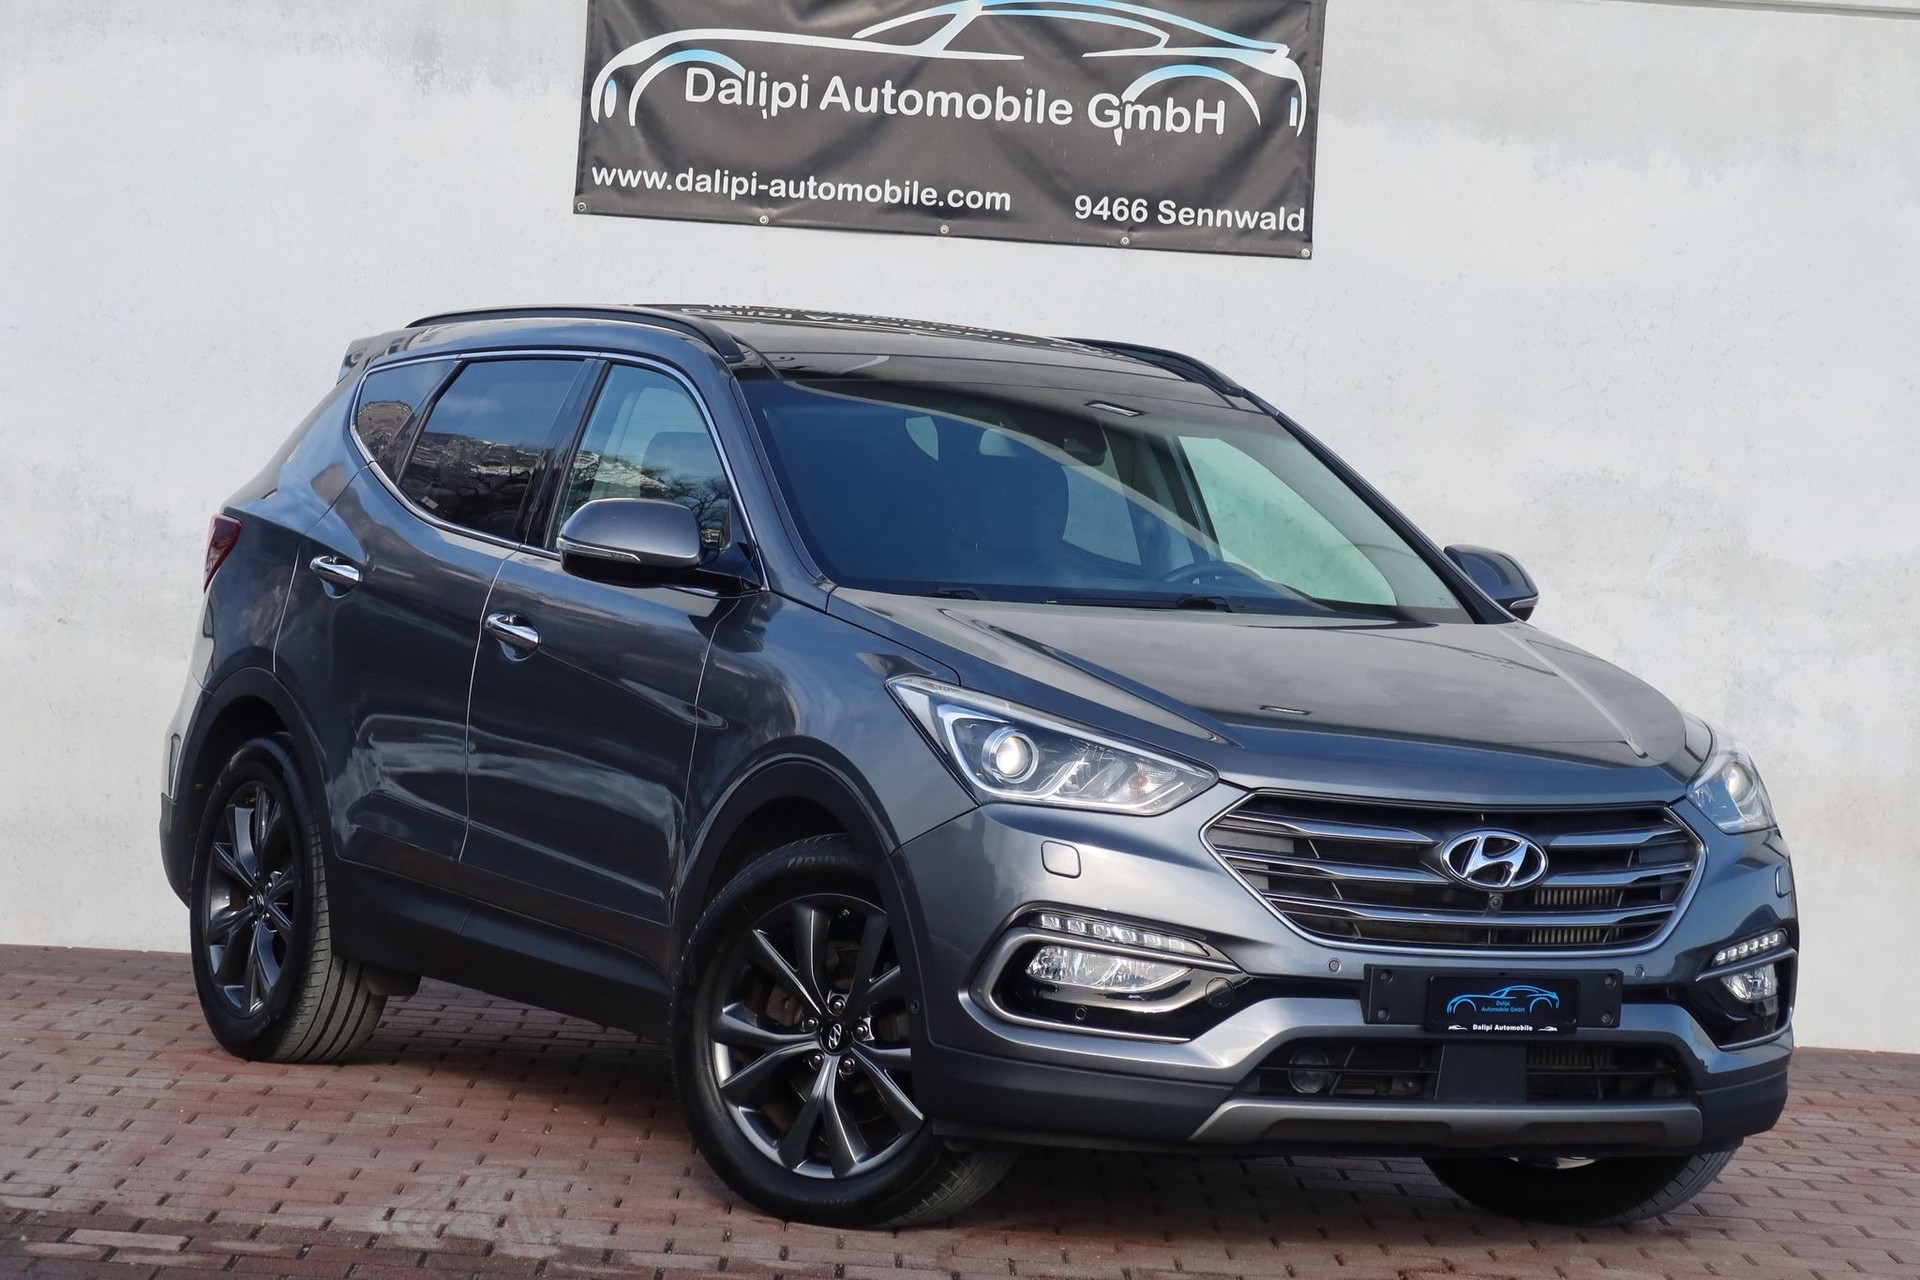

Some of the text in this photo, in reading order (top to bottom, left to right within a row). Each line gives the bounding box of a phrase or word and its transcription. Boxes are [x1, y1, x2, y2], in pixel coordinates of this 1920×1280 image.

[685, 67, 1226, 135] Dalipi Automobile GmbH
[592, 166, 1305, 232] www.dalipi-automobile.com 9466 Sennwald
